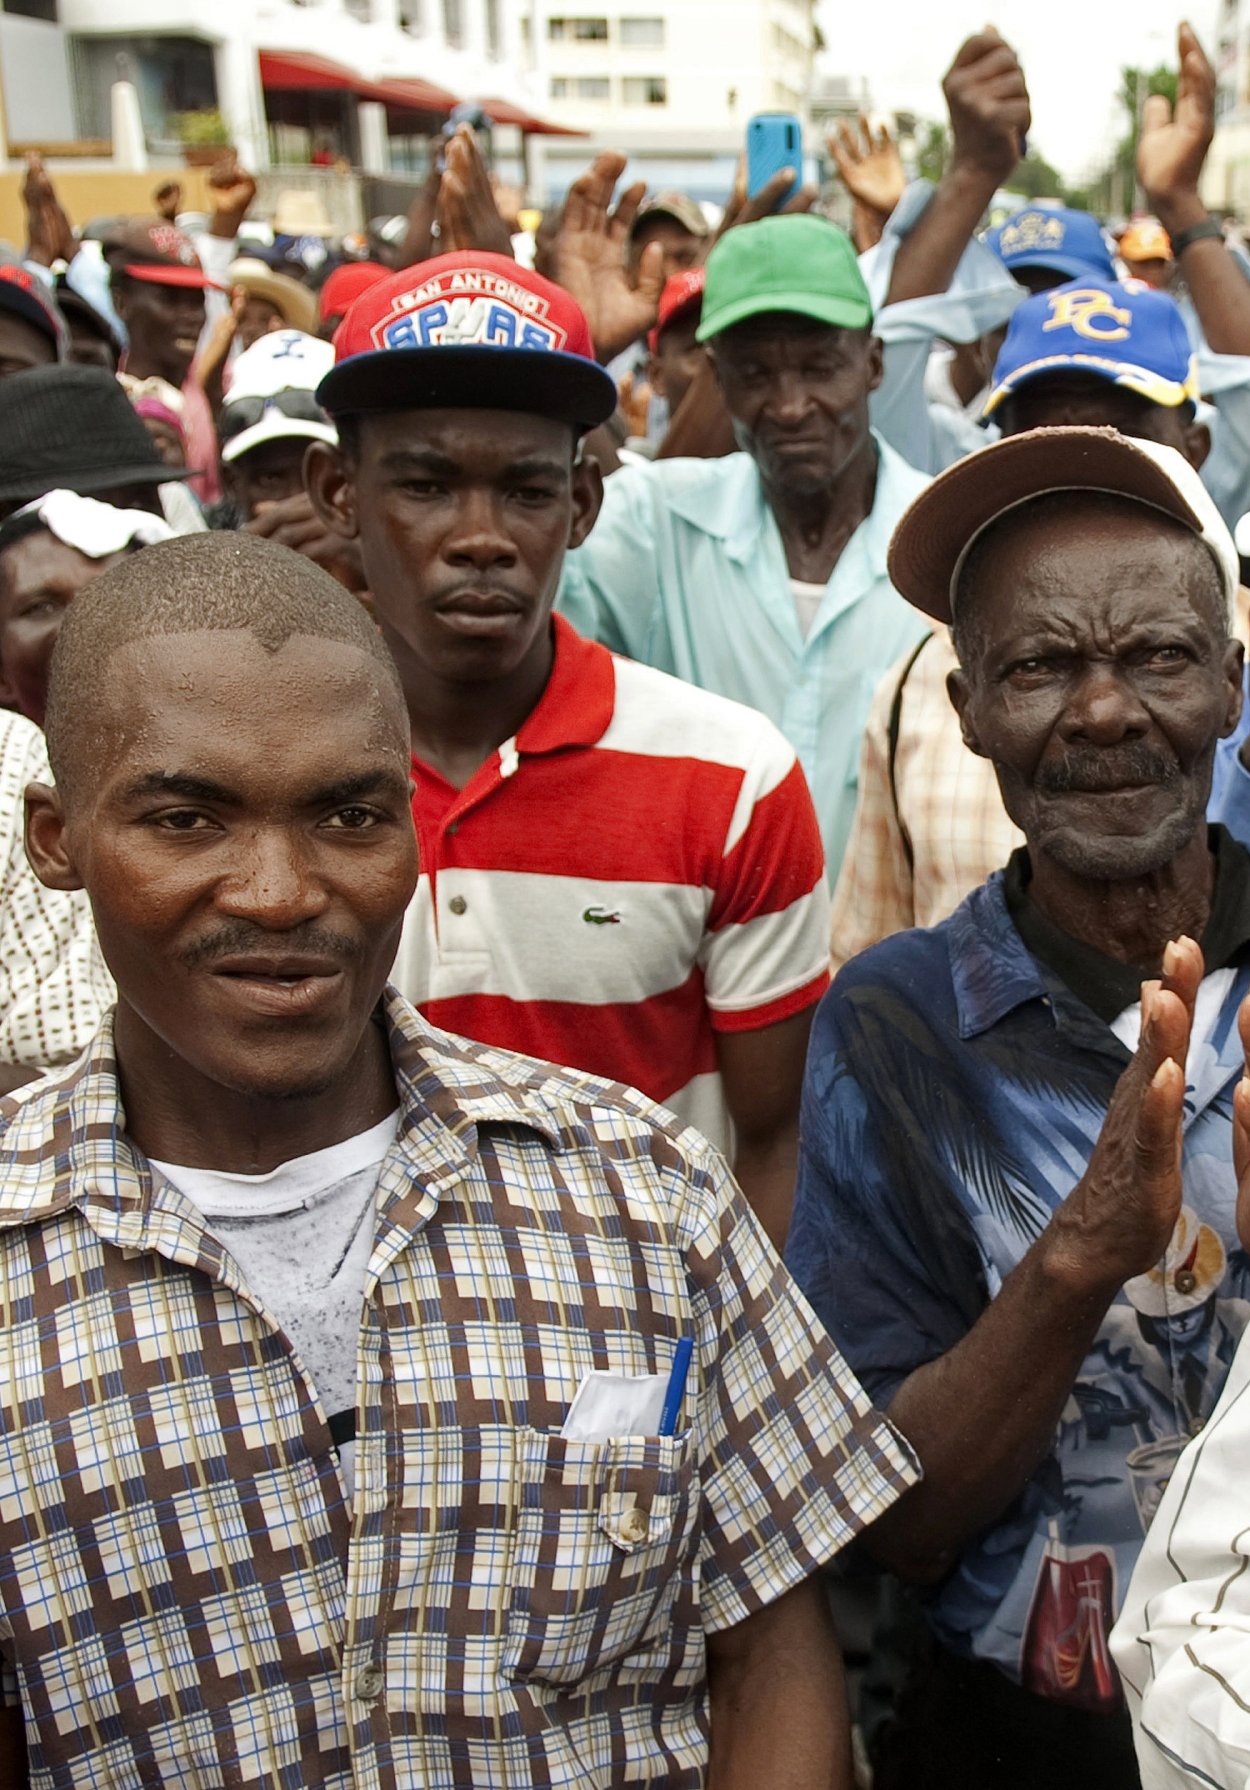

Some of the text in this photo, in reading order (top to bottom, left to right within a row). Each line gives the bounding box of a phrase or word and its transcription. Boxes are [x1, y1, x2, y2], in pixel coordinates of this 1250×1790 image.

[401, 273, 540, 309] SAN ANTONIO
[1043, 289, 1131, 341] PC
